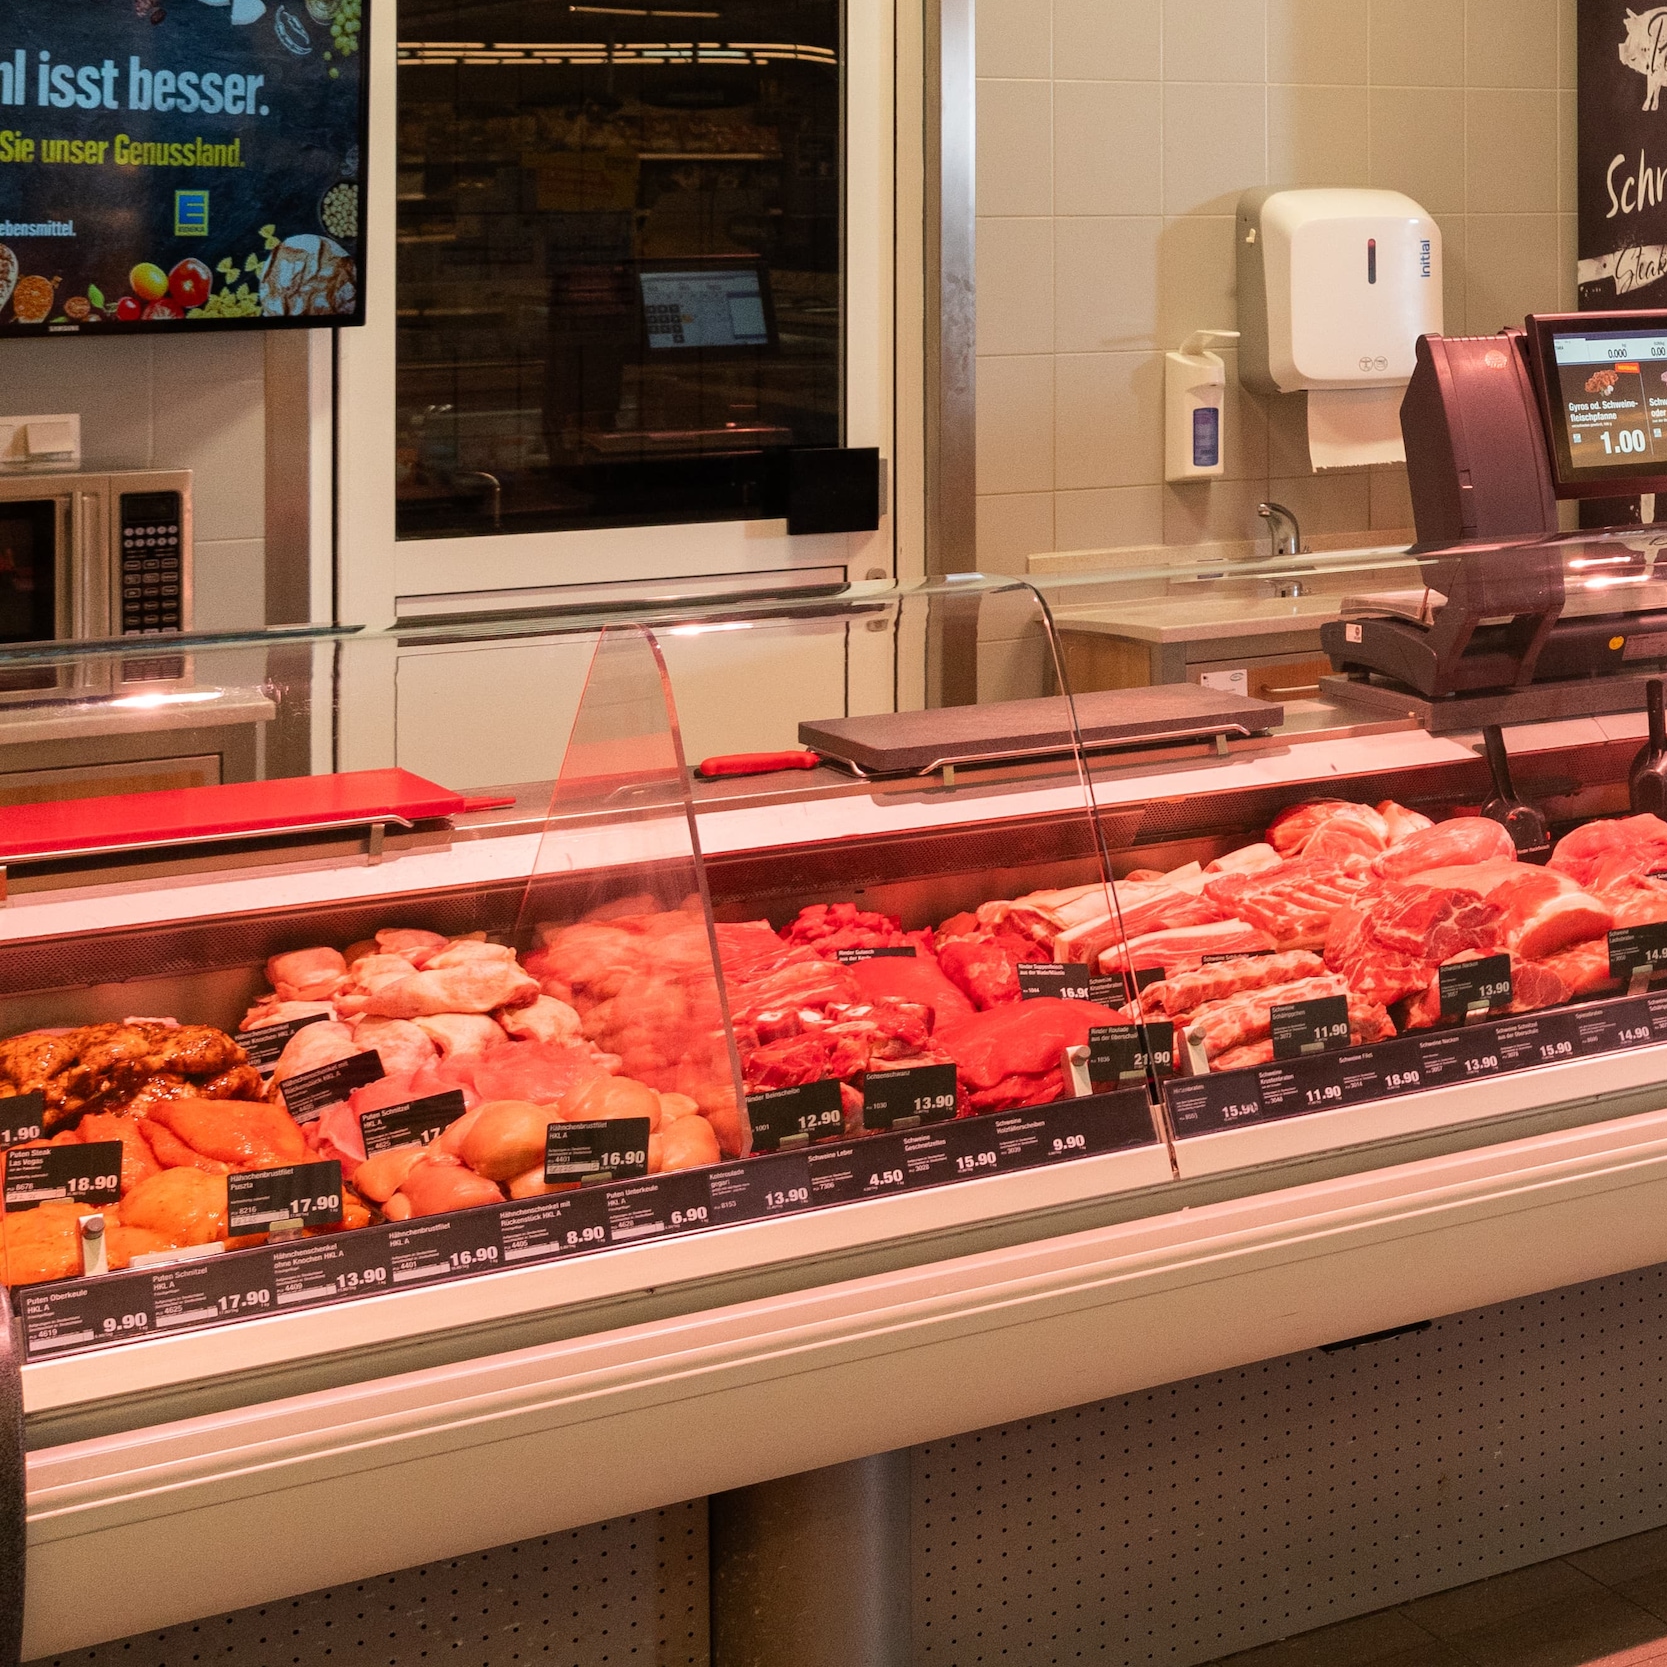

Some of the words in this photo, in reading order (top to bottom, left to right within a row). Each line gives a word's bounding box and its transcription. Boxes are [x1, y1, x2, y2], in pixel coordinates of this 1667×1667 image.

[38, 50, 120, 110] isst
[129, 55, 270, 116] besser.
[0, 130, 34, 163] Sie
[41, 138, 109, 165] unser
[114, 133, 247, 167] Genussland.
[1420, 240, 1430, 277] Initial
[1568, 402, 1589, 412] Gyros
[1602, 400, 1638, 409] Schweine-
[1651, 409, 1666, 417] oder
[1570, 412, 1617, 422] fleischpfanne
[1600, 429, 1646, 454] 1.00
[1479, 981, 1510, 998] 13.90
[1314, 1023, 1348, 1040] 11.90
[1618, 1026, 1650, 1042] 14.90
[1540, 1040, 1572, 1058] 15.90
[1464, 1054, 1498, 1072] 13.90
[1385, 1070, 1420, 1088] 18.90
[913, 1093, 954, 1111] 13.90
[1306, 1085, 1342, 1104] 11.90
[798, 1109, 841, 1130] 12.90
[1053, 1134, 1085, 1151] 9.90
[9, 1149, 28, 1159] Puten
[30, 1147, 51, 1157] Steak
[600, 1149, 645, 1167] 16.90
[808, 1151, 836, 1163] Schweine
[837, 1147, 854, 1159] Leber
[956, 1150, 998, 1171] 15.90
[9, 1159, 20, 1167] Las
[23, 1157, 43, 1168] Vegas
[67, 1174, 118, 1193] 18.90
[230, 1167, 294, 1182] Hähnchenbrustfilet
[869, 1168, 904, 1187] 4.50
[230, 1182, 254, 1191] Puszta
[606, 1189, 625, 1200] Puten
[625, 1183, 659, 1197] Unterkeule
[290, 1194, 339, 1215] 17.90
[765, 1186, 809, 1207] 13.90
[500, 1203, 559, 1220] Hähnchenschenkel
[560, 1199, 571, 1209] mit
[670, 1205, 708, 1226] 6.90
[389, 1222, 451, 1240] Hähnchenbrustfilet
[566, 1225, 605, 1246] 8.90
[273, 1243, 337, 1261] Hähnchenschenkel
[274, 1258, 291, 1268] ohne
[292, 1253, 322, 1266] Knochen
[450, 1245, 499, 1266] 16.90
[153, 1272, 174, 1283] Puten
[175, 1266, 208, 1280] Schnitzel
[336, 1267, 387, 1289] 13.90
[153, 1282, 168, 1291] HKL
[26, 1295, 49, 1306] Puten
[50, 1289, 88, 1302] Oberkeule
[218, 1289, 270, 1312] 17.90
[27, 1305, 42, 1314] HKL
[103, 1312, 148, 1332] 9.90
